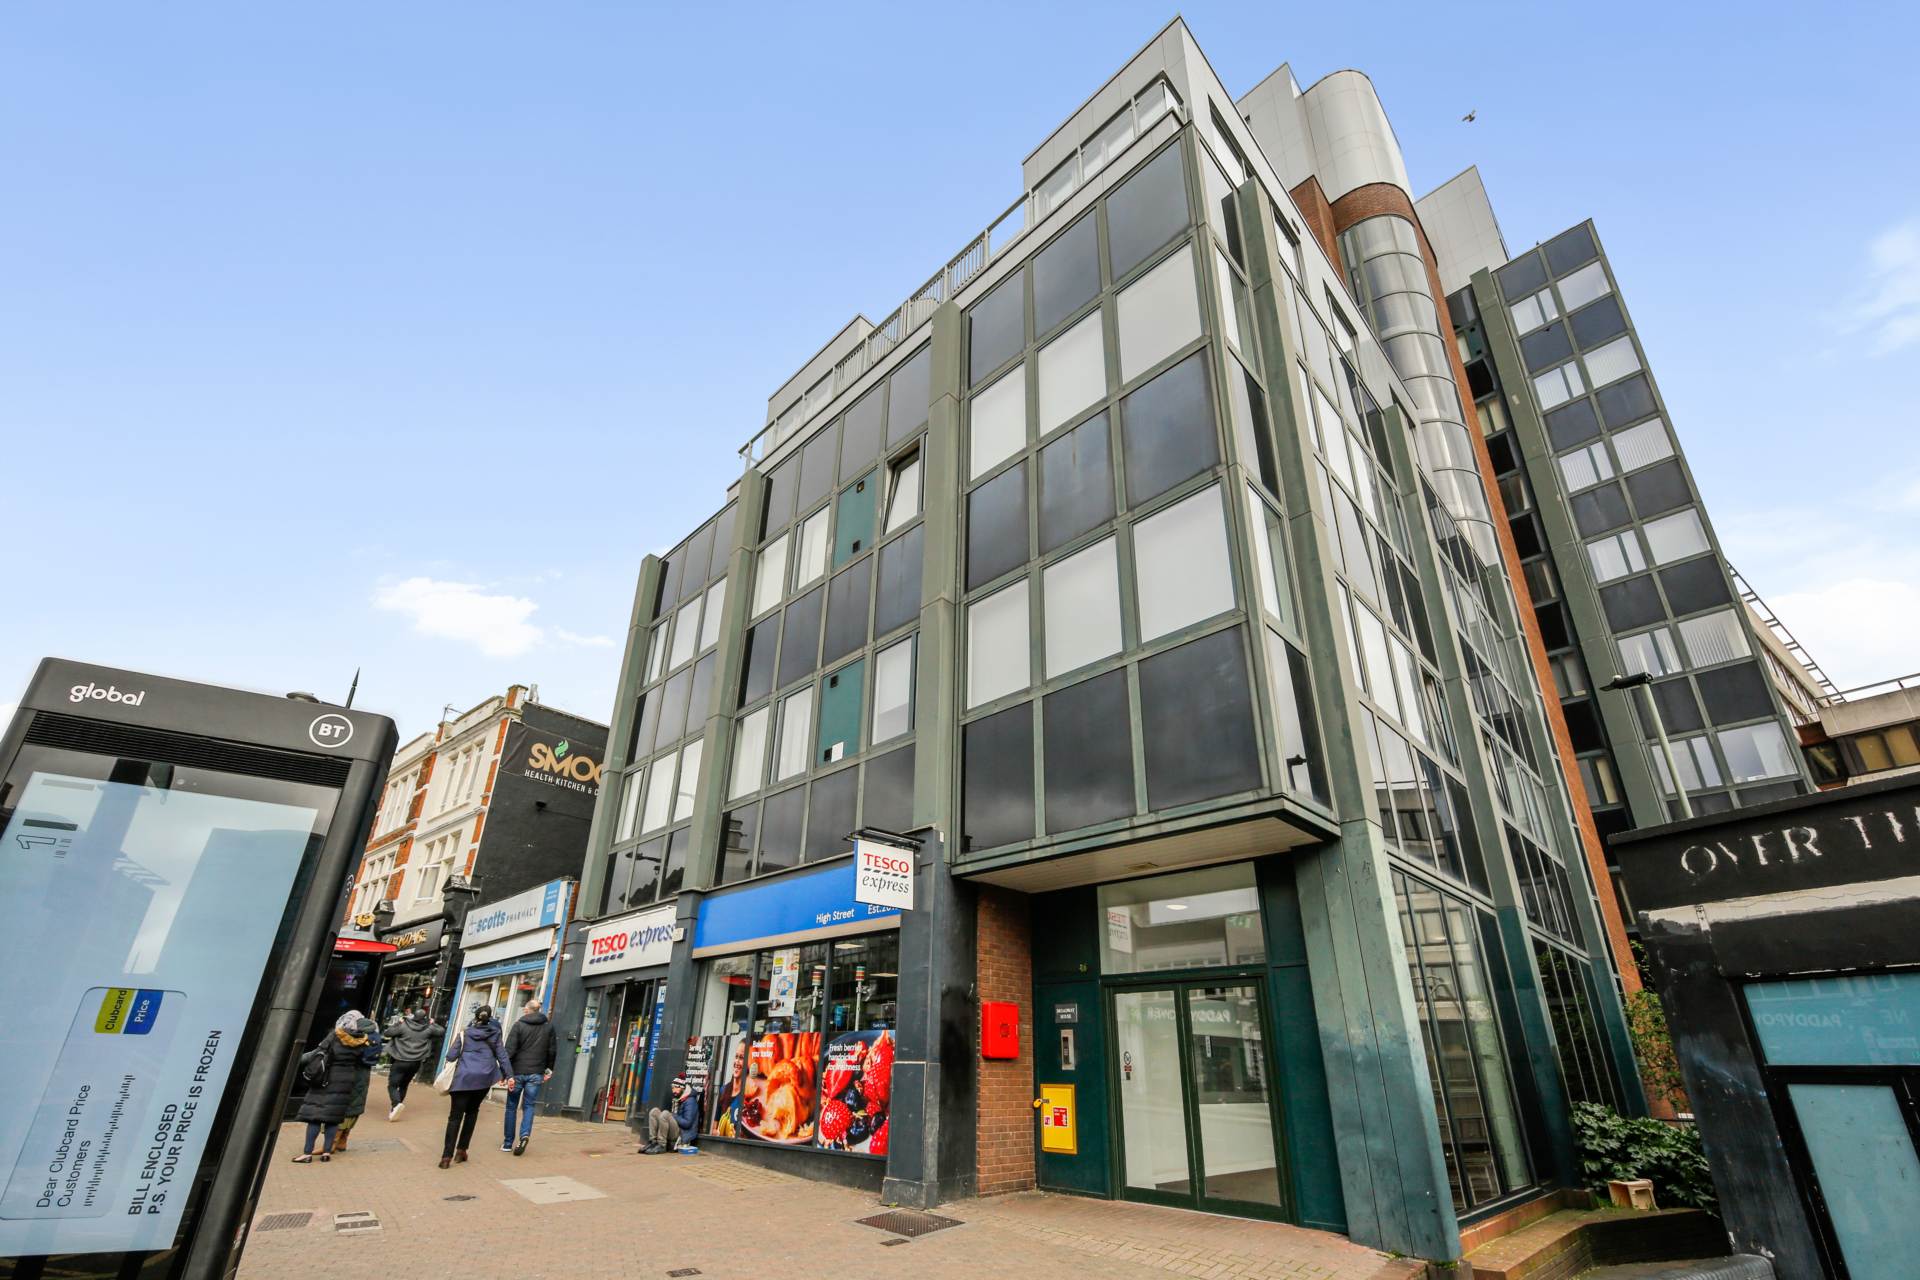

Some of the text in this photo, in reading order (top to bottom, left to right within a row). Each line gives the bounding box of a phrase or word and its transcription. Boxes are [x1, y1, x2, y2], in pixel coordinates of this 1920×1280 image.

[70, 682, 145, 706] global
[318, 723, 345, 738] BT
[524, 769, 554, 783] HEALTH
[555, 777, 586, 793] KITCHEN
[863, 853, 910, 873] TESCO
[862, 875, 910, 894] express
[476, 910, 507, 933] scotts
[816, 911, 832, 925] High
[833, 908, 855, 921] Street
[592, 932, 628, 956] TESCO
[105, 989, 128, 1031] Clubcard
[134, 999, 151, 1024] Price
[829, 1043, 843, 1051] Fresh
[148, 1030, 223, 1215] P.S. YOUR PRICE IS FROZEN
[36, 1084, 91, 1208] Dear Clubcard Price
[128, 1103, 178, 1216] BILL ENCLOSED
[57, 1139, 91, 1207] Customers
